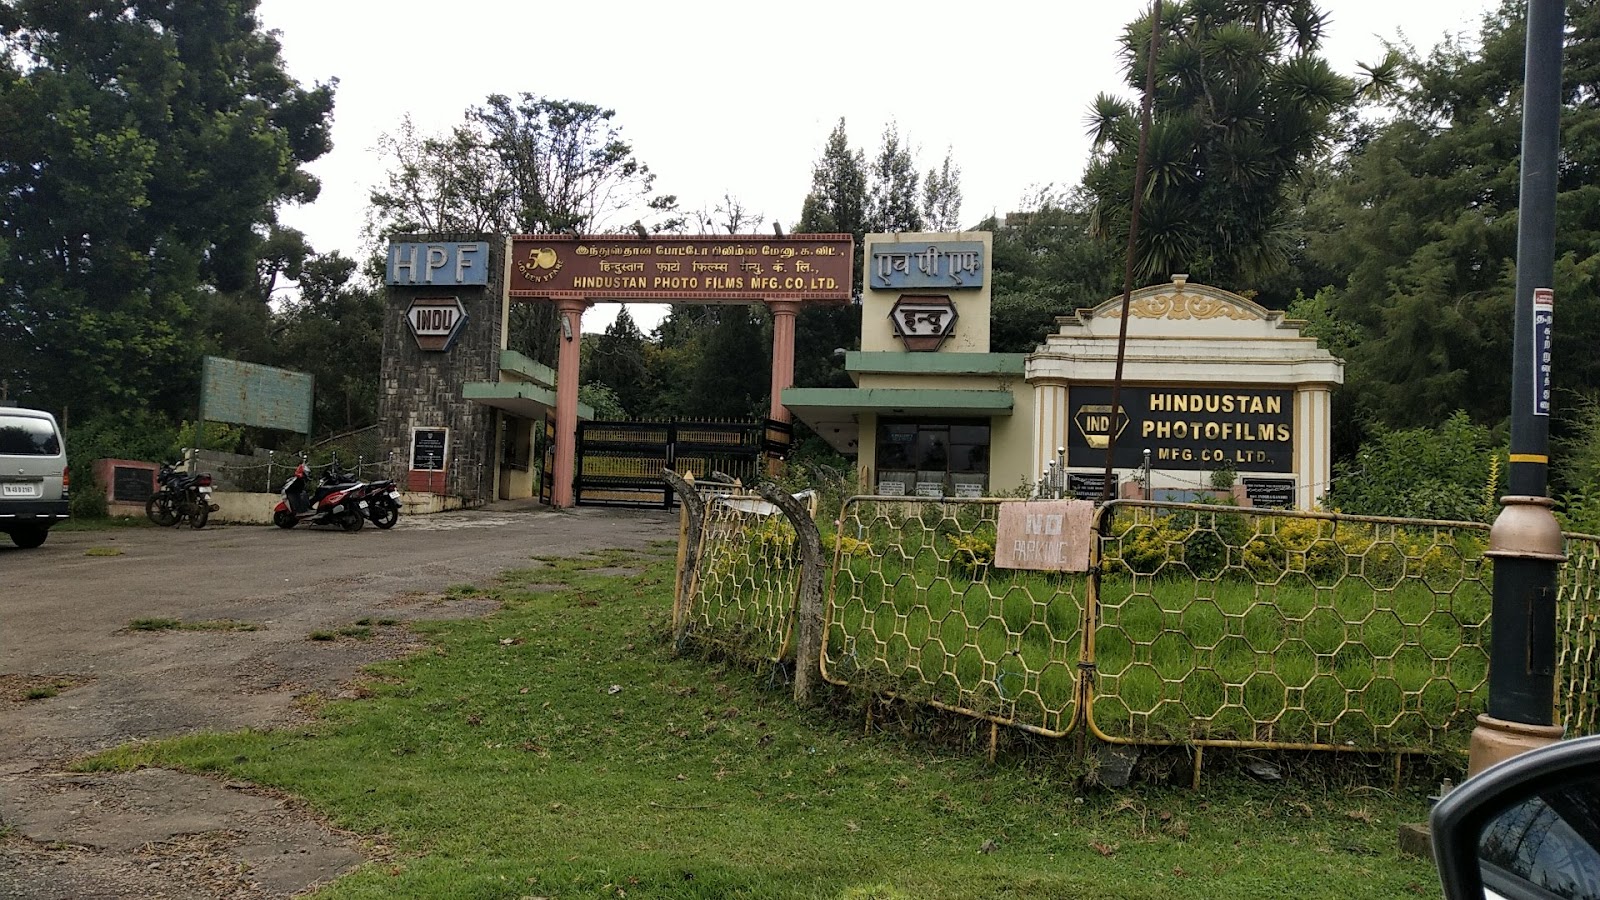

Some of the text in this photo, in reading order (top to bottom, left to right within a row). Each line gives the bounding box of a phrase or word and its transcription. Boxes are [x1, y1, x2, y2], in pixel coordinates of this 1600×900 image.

[393, 245, 478, 283] HPF
[525, 247, 557, 270] 50
[874, 245, 980, 286] एच पी एफ
[573, 276, 647, 289] HINDUSTAN
[654, 276, 698, 289] PHOTO
[705, 276, 744, 290] FILMS
[416, 309, 453, 331] INDU
[1150, 393, 1281, 414] HINDUSTAN
[1086, 415, 1119, 433] IND
[1142, 420, 1290, 442] PHOTOFILMS
[1025, 513, 1063, 536] NO
